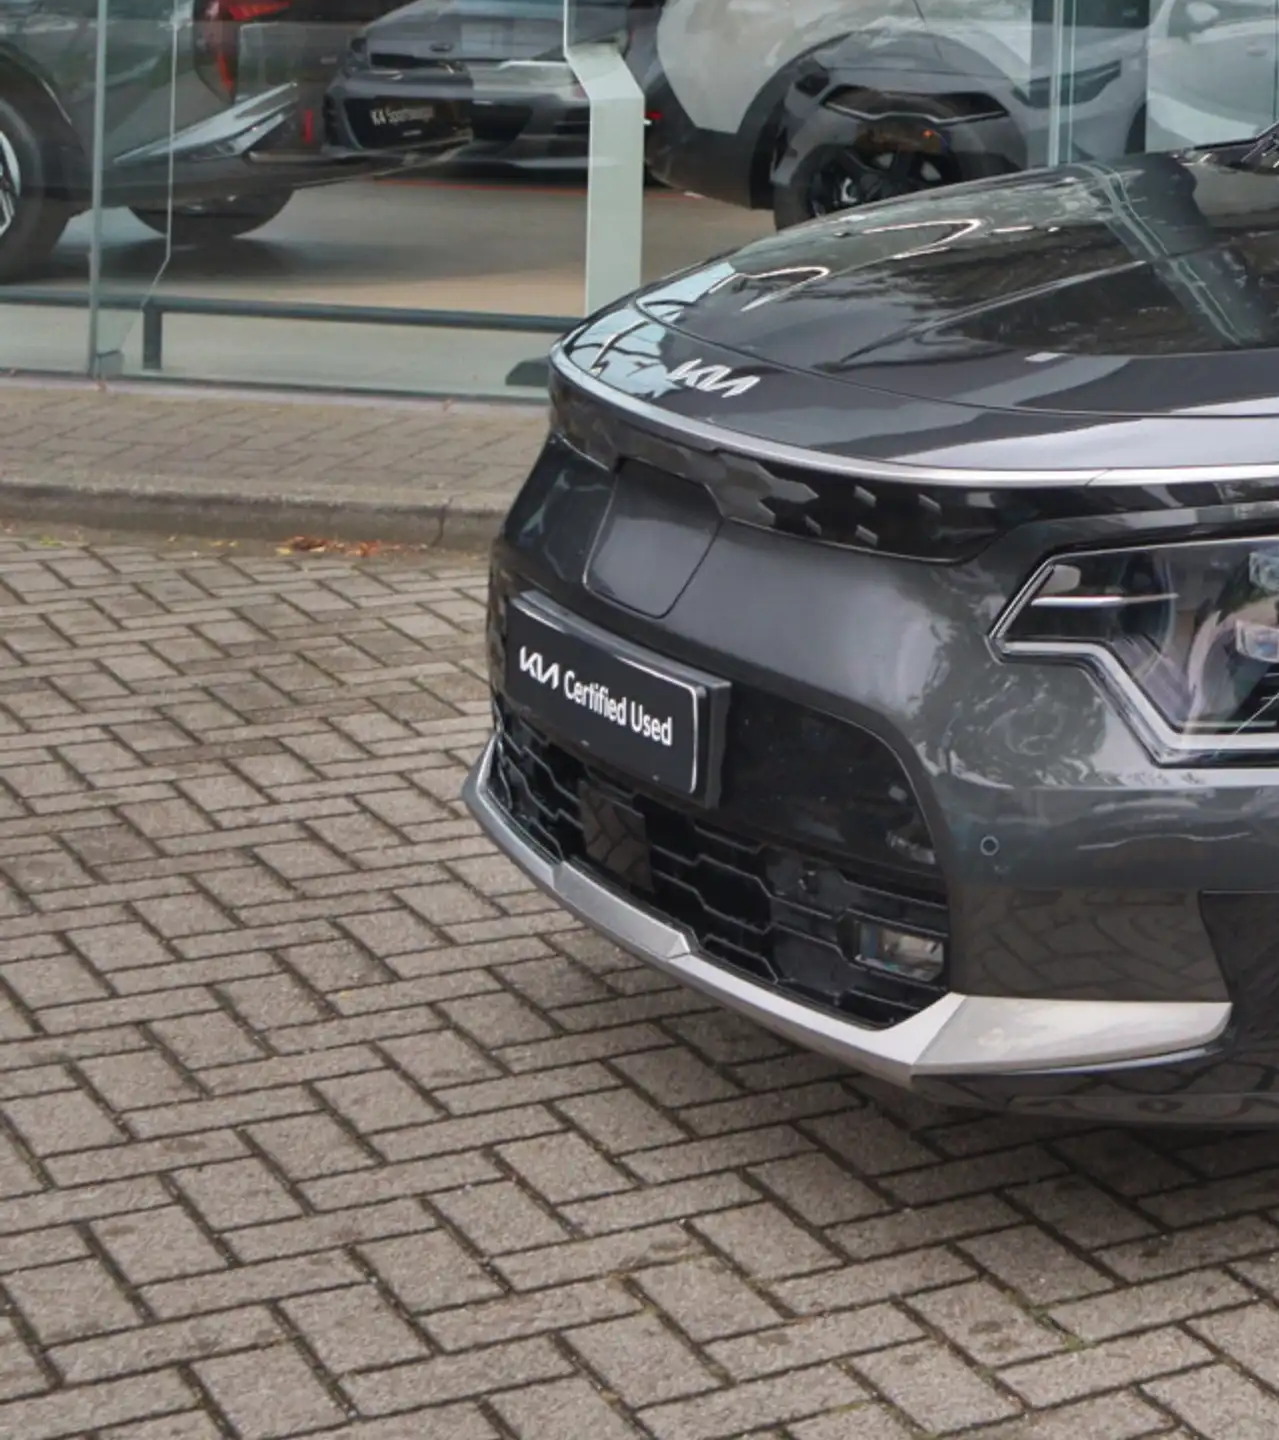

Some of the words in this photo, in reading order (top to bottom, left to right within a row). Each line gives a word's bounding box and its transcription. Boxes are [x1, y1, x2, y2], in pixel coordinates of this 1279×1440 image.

[666, 358, 760, 398] KIA
[519, 645, 560, 690] KIA
[563, 670, 627, 726] Certified
[631, 701, 673, 746] Used
